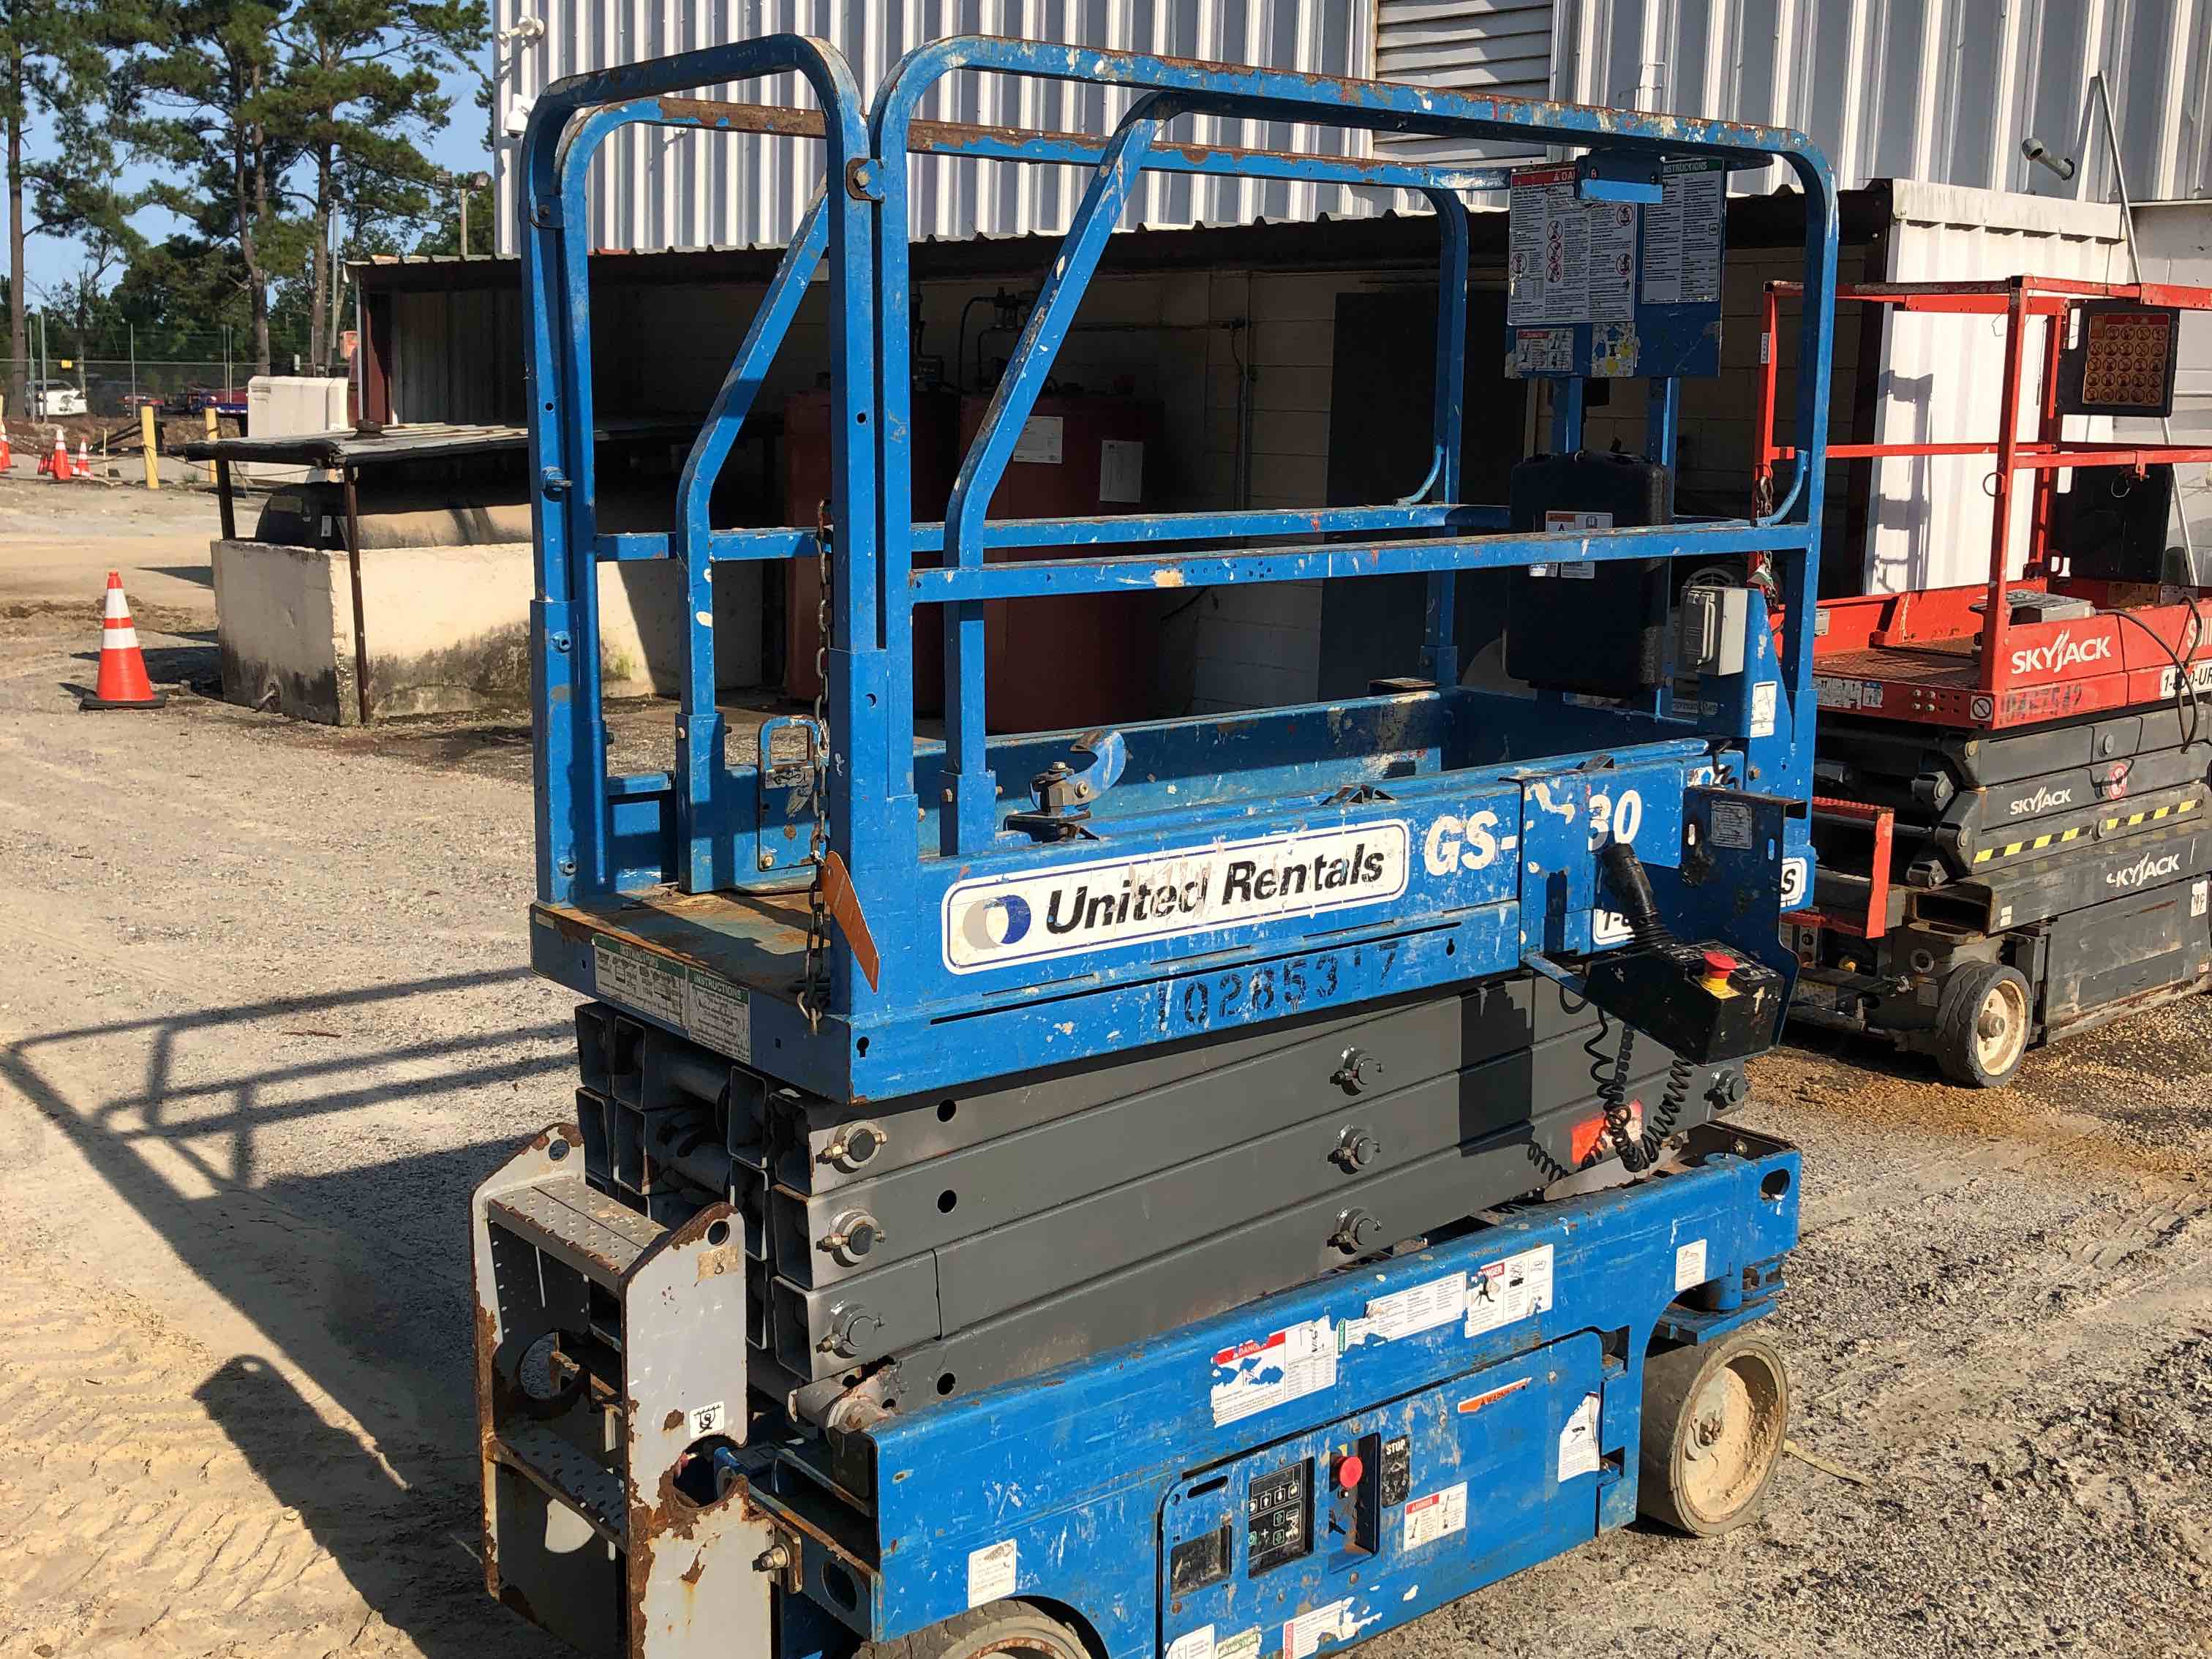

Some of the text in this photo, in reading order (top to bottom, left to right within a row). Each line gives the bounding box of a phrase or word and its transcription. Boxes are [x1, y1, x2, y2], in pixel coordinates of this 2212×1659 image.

[2012, 629, 2112, 674] SKYJACK
[2010, 786, 2072, 815] SKYJACK
[1046, 843, 1385, 935] United Rentals
[1385, 1439, 1406, 1456] STOP
